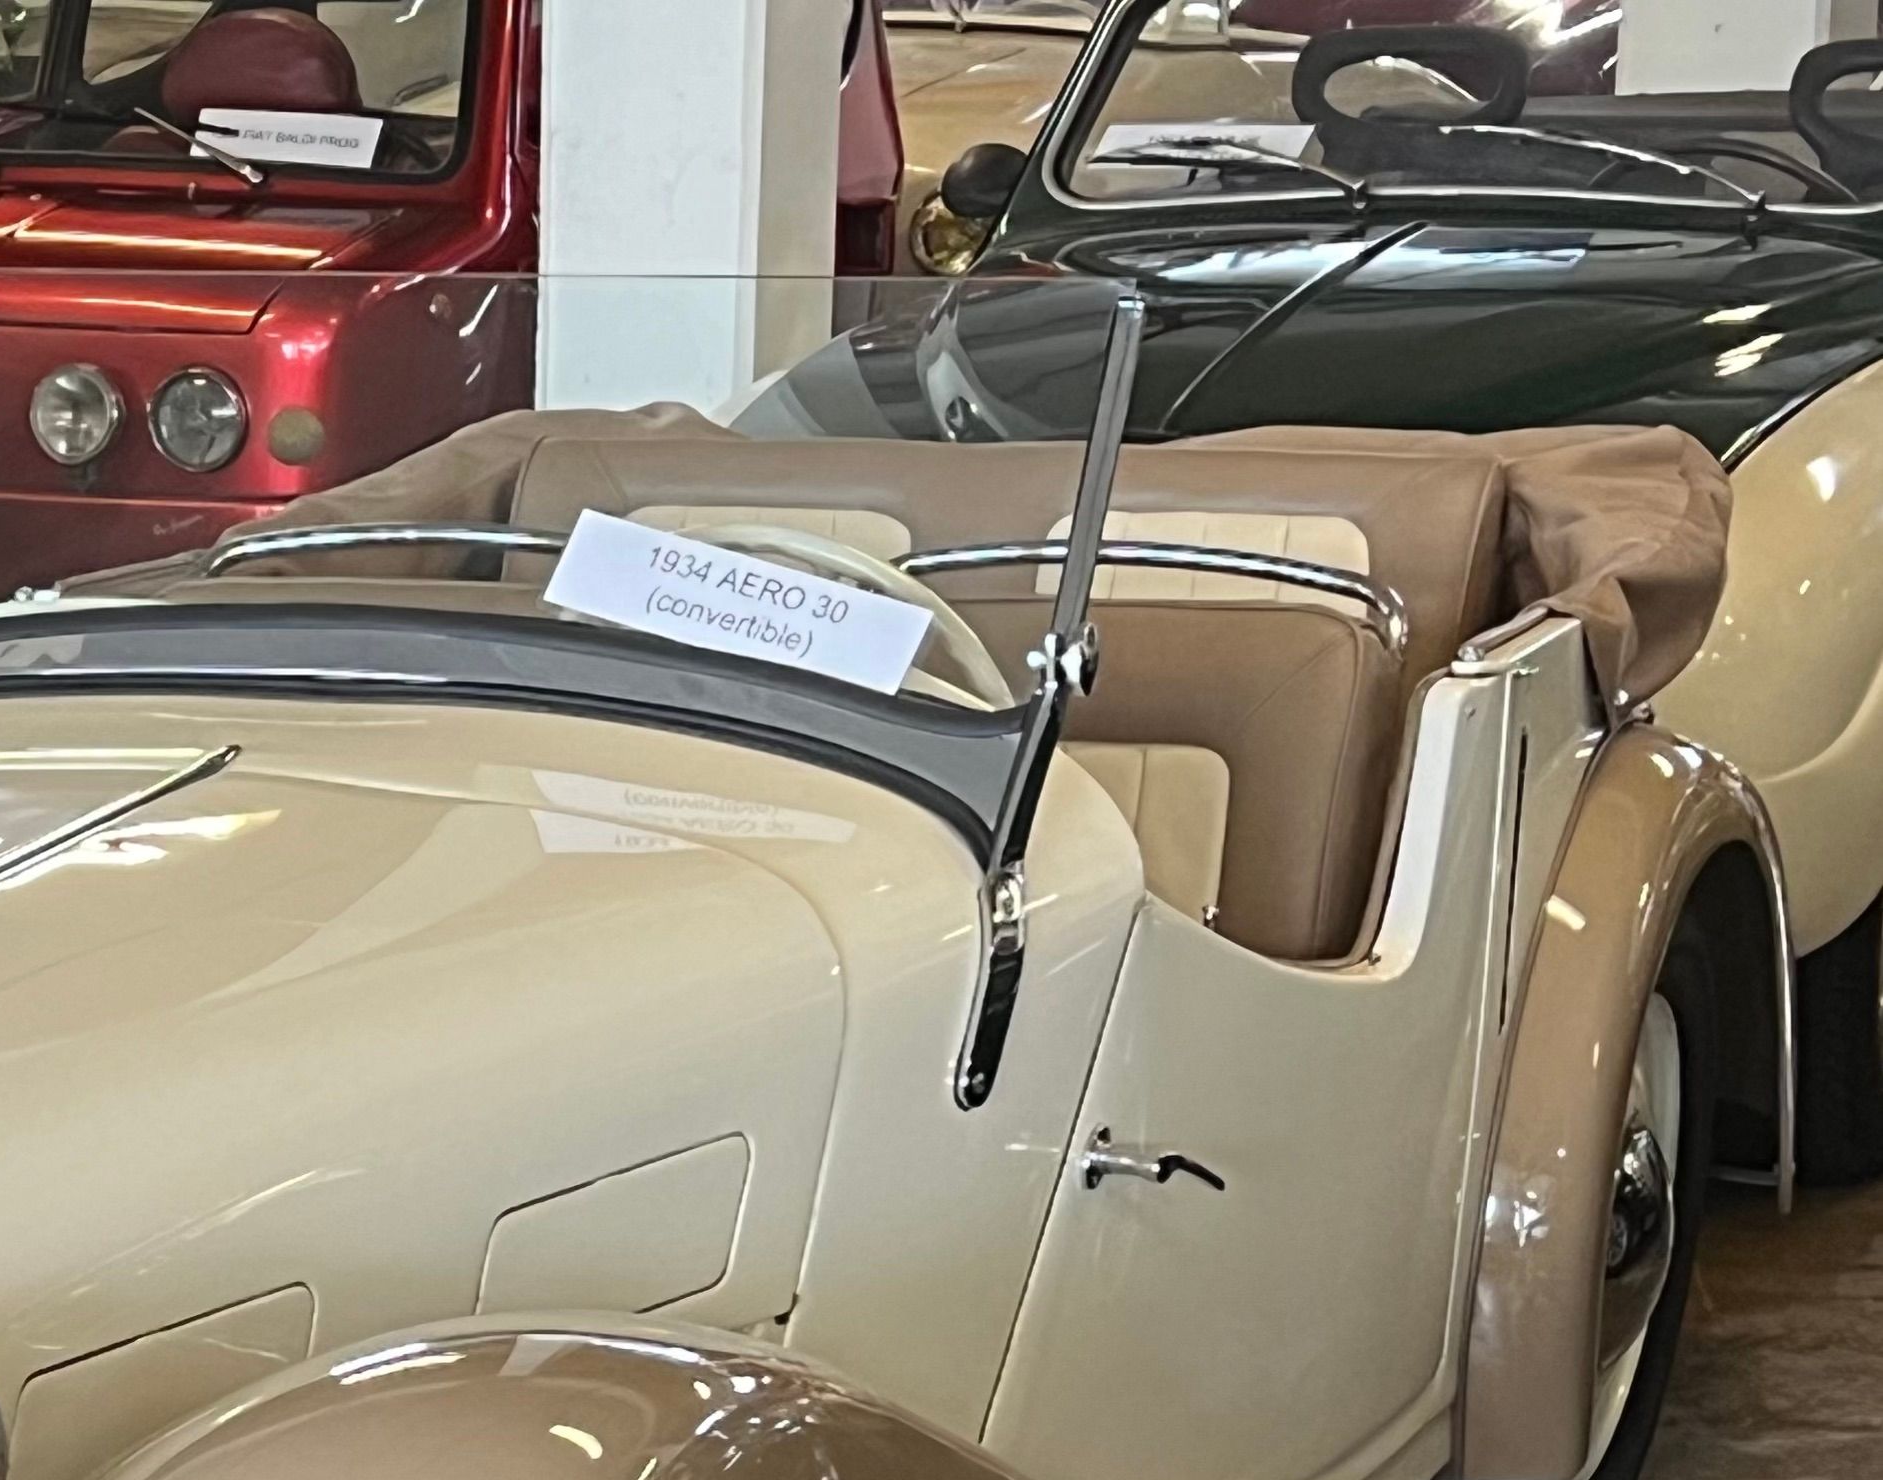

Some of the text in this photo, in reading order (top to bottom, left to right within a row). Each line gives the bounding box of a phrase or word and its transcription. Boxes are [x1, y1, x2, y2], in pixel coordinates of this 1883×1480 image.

[646, 586, 813, 659] (convertible)
[650, 546, 849, 624] 1934 AERO 30
